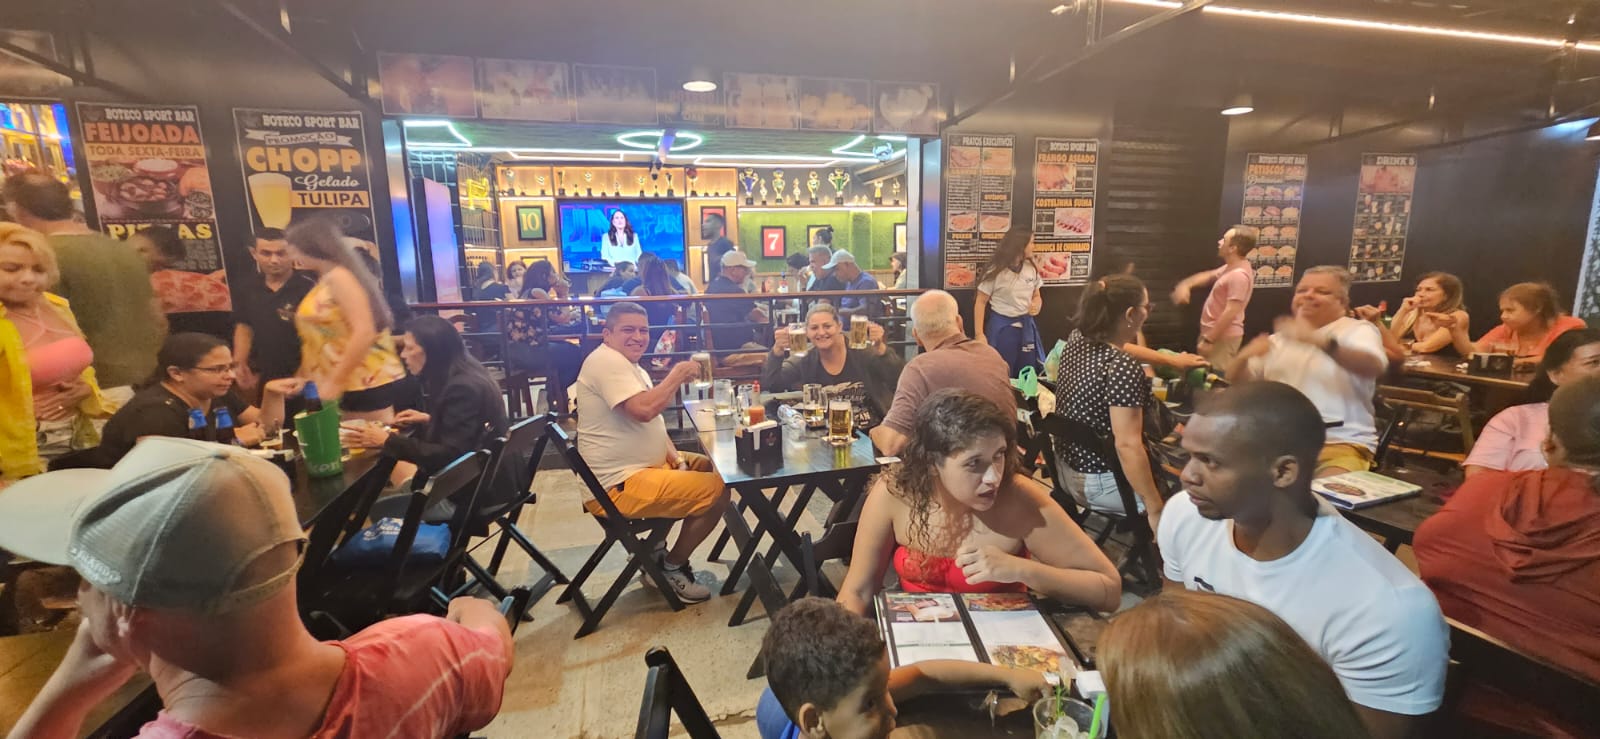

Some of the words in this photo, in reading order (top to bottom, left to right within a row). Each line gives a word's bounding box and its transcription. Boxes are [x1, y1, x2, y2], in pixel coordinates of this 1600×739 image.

[105, 108, 142, 120] BOTECO
[143, 109, 173, 121] SPORT
[174, 110, 195, 122] BAR
[262, 114, 302, 127] BOTECO
[304, 116, 336, 128] SPORT
[338, 117, 360, 129] BAR
[84, 122, 200, 143] FEIJOADA
[89, 145, 124, 156] TODA
[128, 146, 201, 157] SEXTA-FEIRA
[1038, 153, 1067, 162] FRANGO
[246, 146, 361, 172] CHOPP
[1248, 164, 1284, 176] PETISCOS
[294, 174, 360, 190] Gelado
[298, 193, 364, 205] TULIPA
[1036, 198, 1072, 207] COSTELINHA
[520, 214, 541, 231] 10
[107, 223, 212, 240] PIAS
[768, 233, 780, 251] 7
